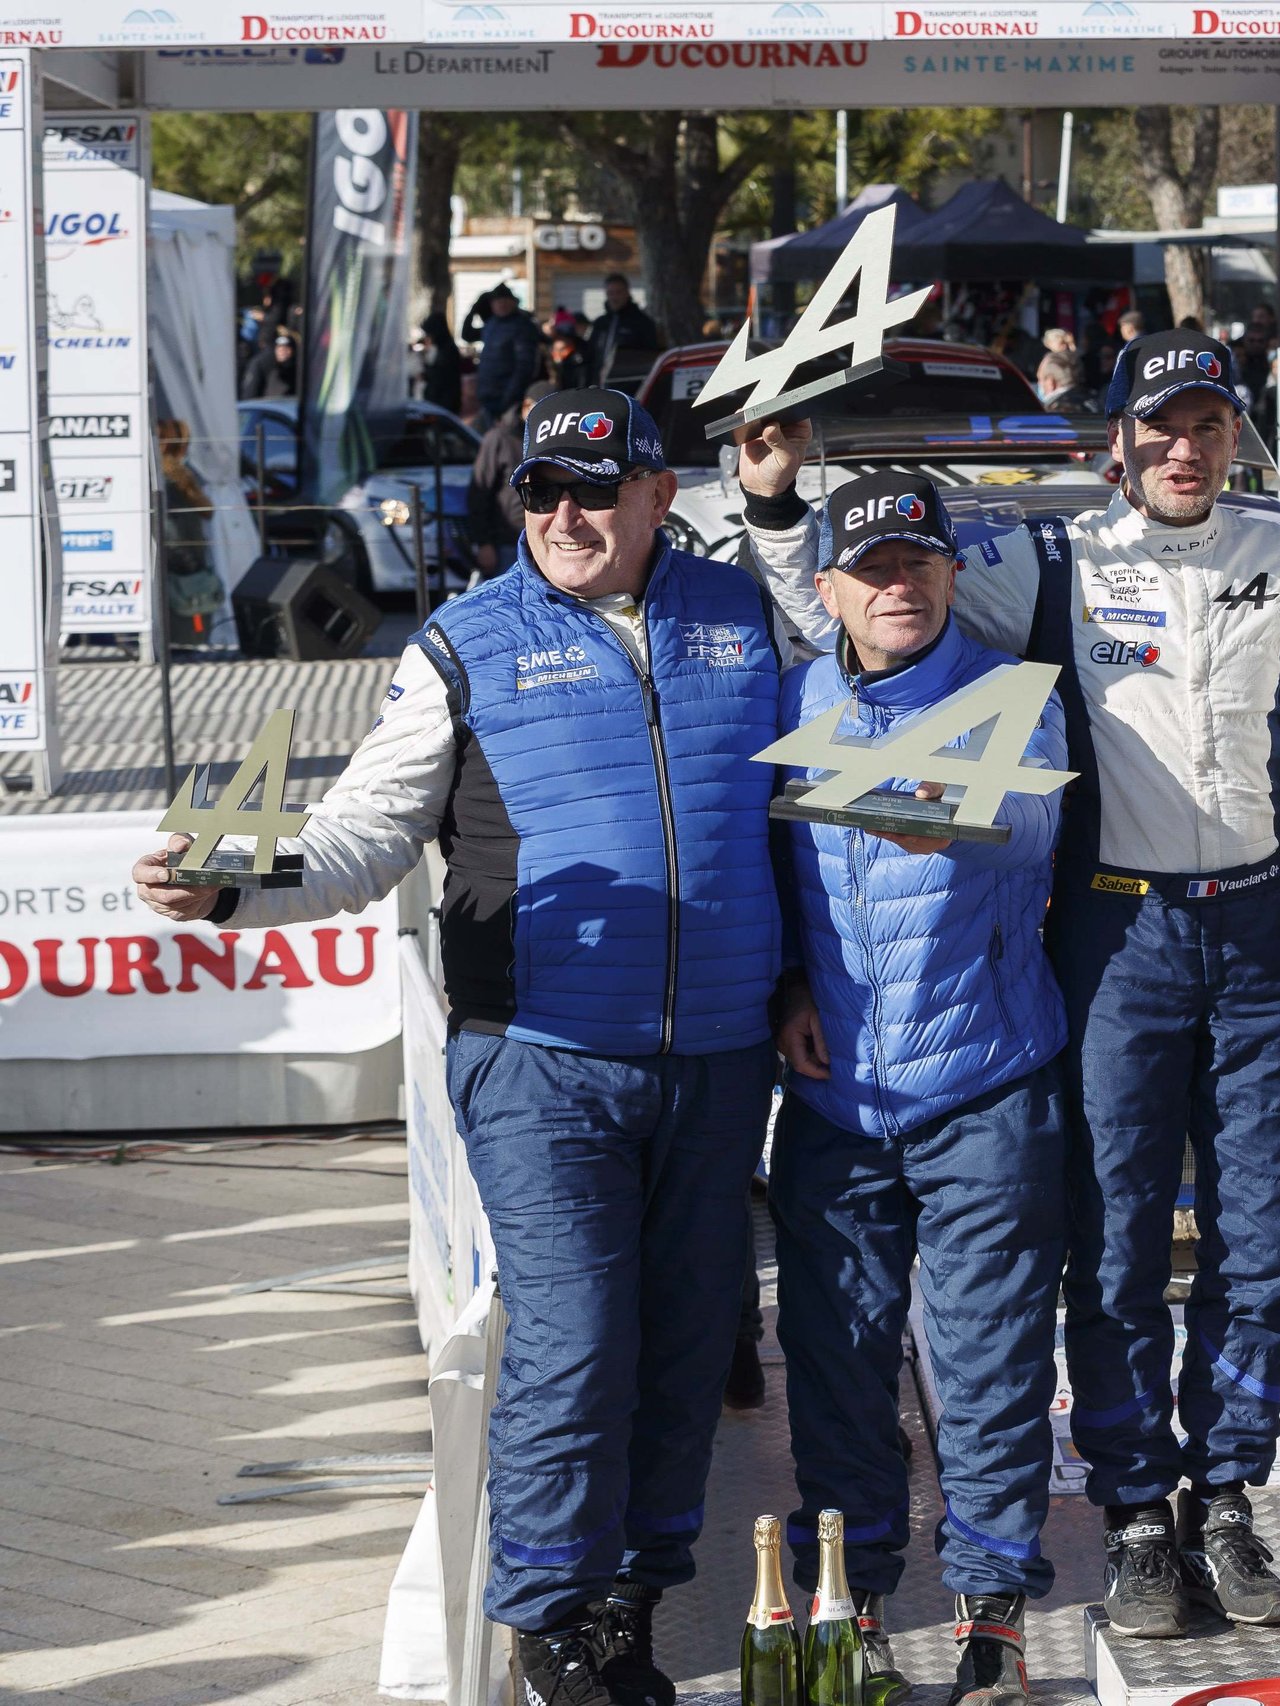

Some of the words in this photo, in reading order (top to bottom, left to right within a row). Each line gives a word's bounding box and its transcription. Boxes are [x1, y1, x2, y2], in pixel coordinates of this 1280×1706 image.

[241, 16, 386, 41] DUCOURNAU
[569, 14, 715, 38] DUCOURNAU
[895, 12, 1038, 36] DUCOURNAU
[596, 43, 869, 68] DUCOURNAU
[1159, 48, 1210, 59] GROUPE
[904, 56, 1136, 73] SAINTE-MAXIME
[47, 338, 131, 350] CHELIN
[1040, 522, 1063, 562] Sabelt
[1161, 528, 1218, 553] ALPINE
[1092, 571, 1160, 585] ALPINE
[64, 581, 129, 596] FSA
[1110, 594, 1142, 603] RALLY
[1106, 612, 1160, 623] MICHELIN
[687, 644, 736, 658] FFSA
[1090, 640, 1138, 665] elf
[516, 650, 564, 671] SME
[708, 656, 745, 668] RALLYE
[537, 668, 592, 682] MICHELIN
[1097, 876, 1146, 893] Sabelt
